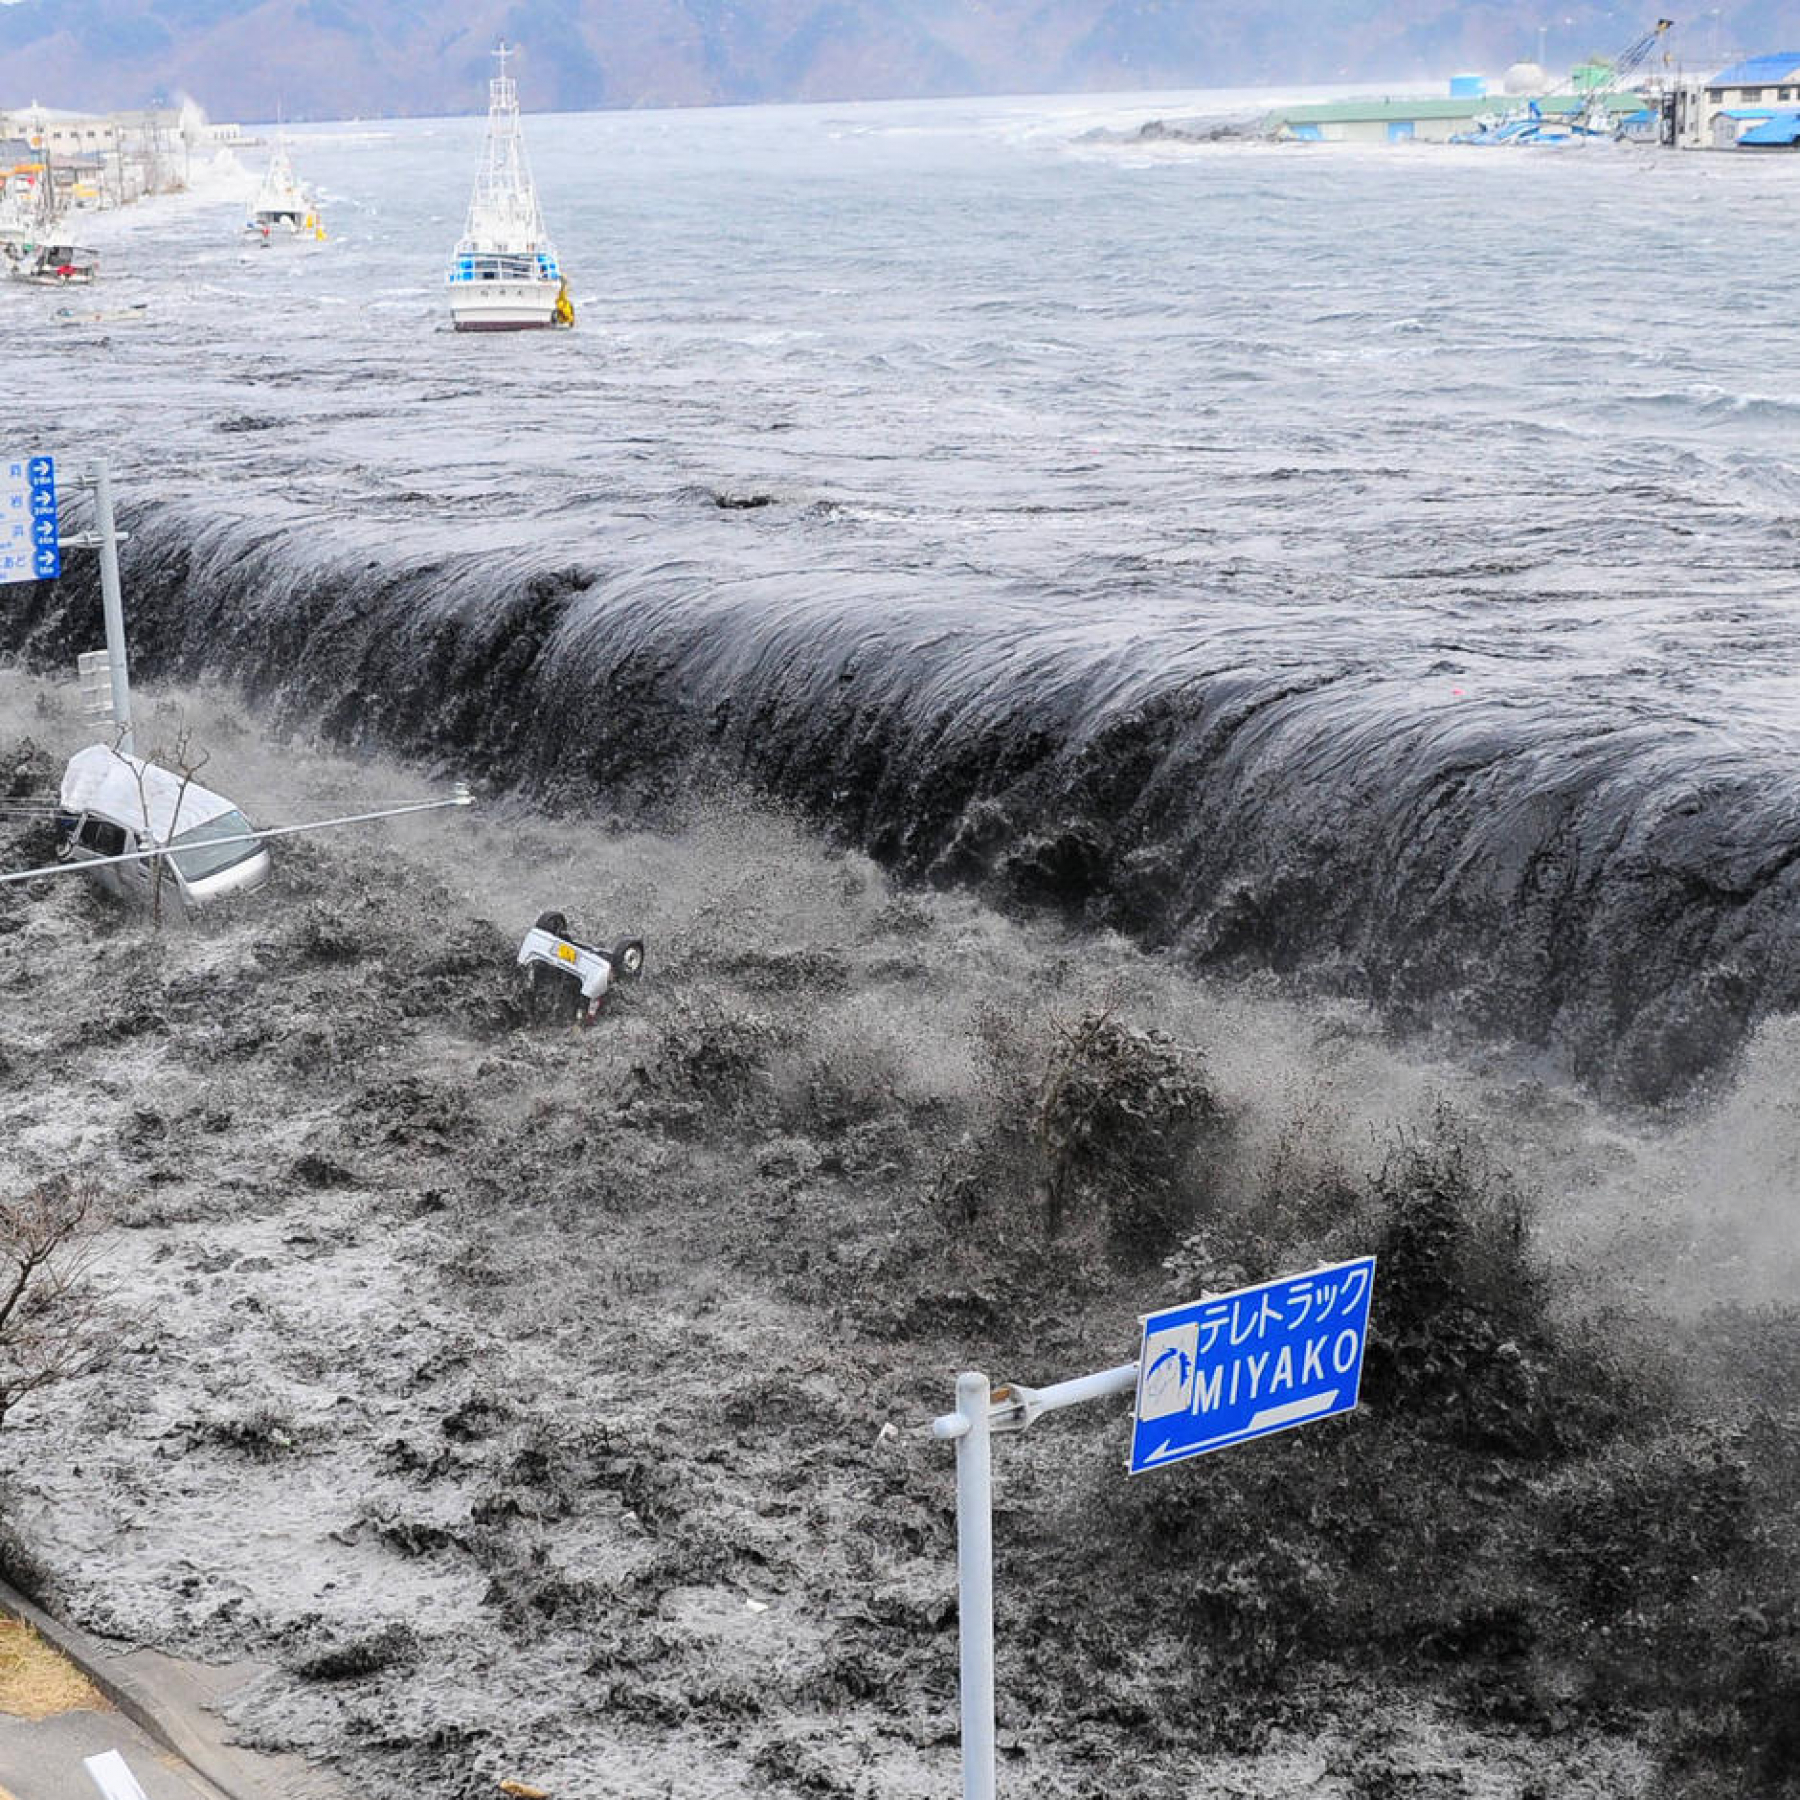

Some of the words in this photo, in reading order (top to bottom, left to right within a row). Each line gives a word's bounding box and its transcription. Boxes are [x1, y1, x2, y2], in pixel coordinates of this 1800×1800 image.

[1200, 1268, 1369, 1354] テレトラック
[1191, 1328, 1359, 1416] MIYAKO
